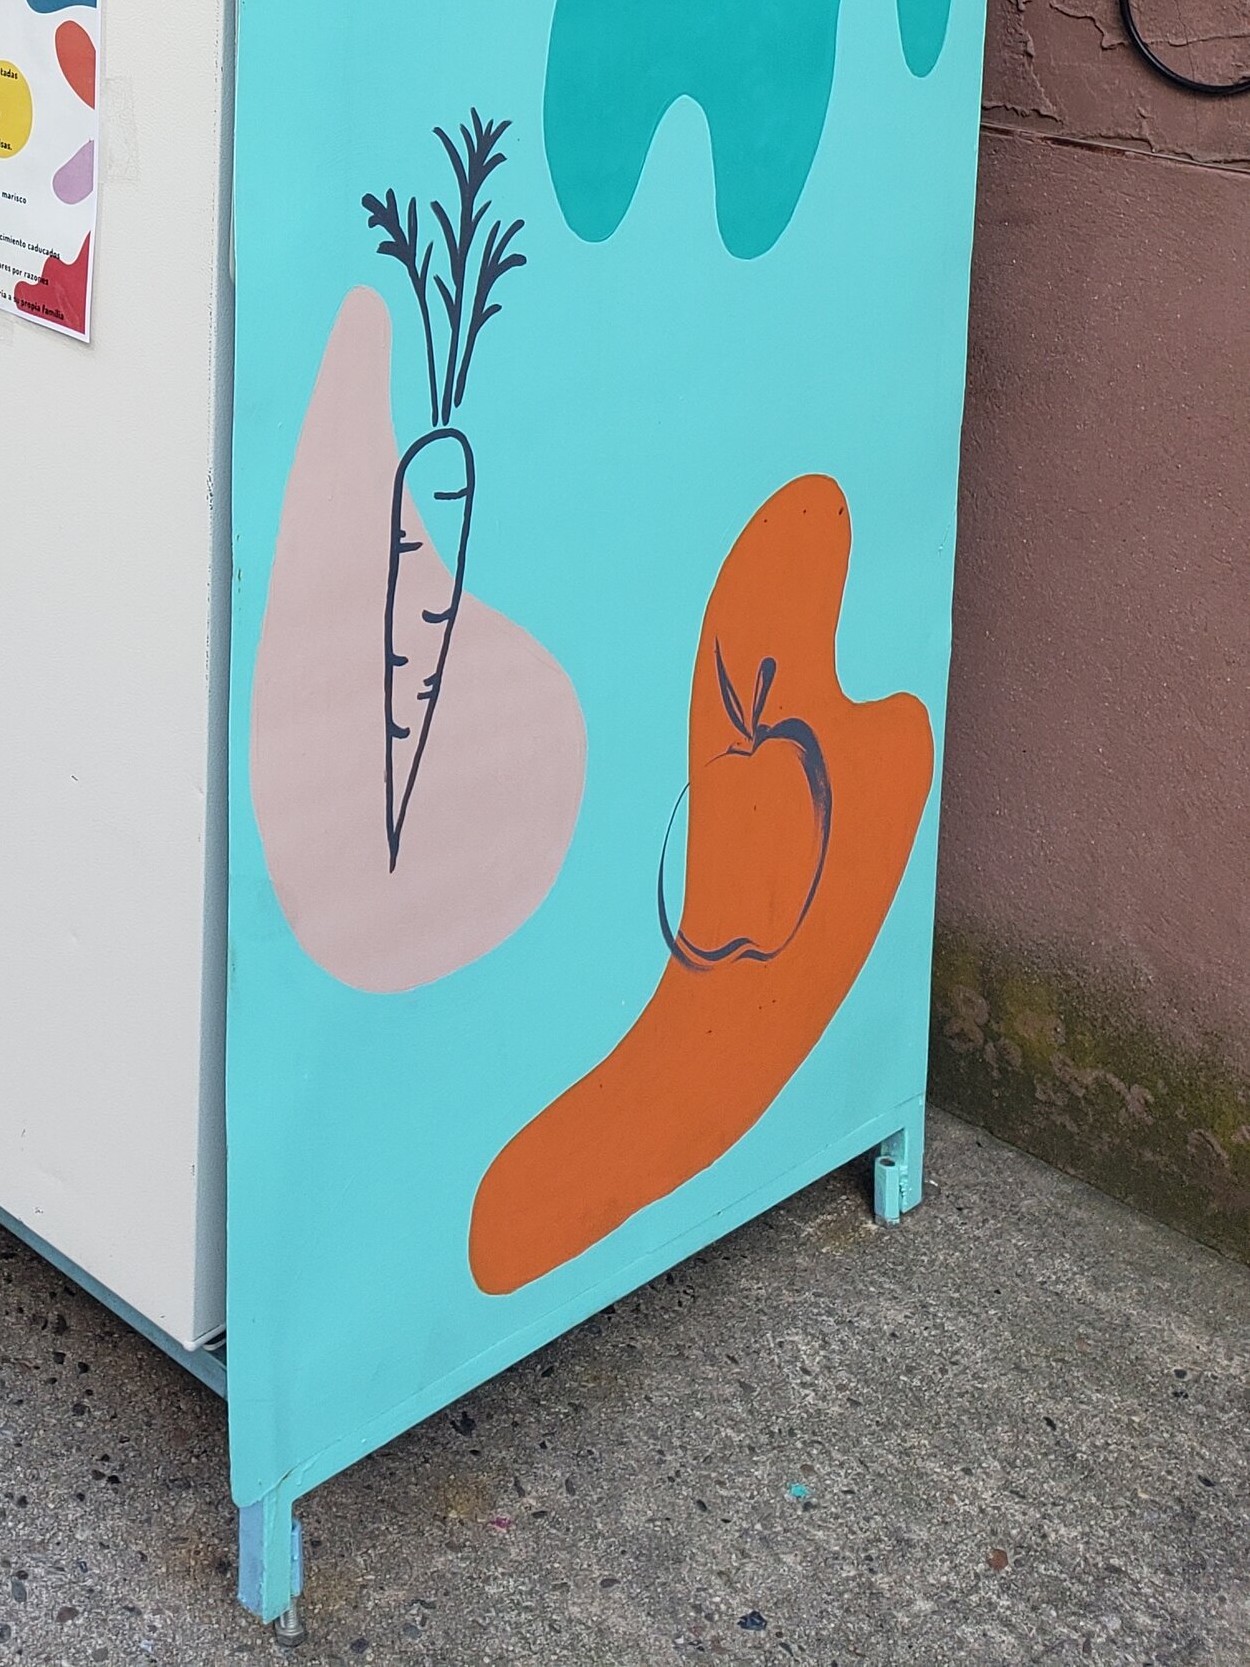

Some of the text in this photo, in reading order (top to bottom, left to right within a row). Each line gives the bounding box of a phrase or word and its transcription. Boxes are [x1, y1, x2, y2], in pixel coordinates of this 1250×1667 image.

[2, 191, 27, 204] marisco
[28, 241, 60, 260] caducados
[12, 267, 22, 279] por
